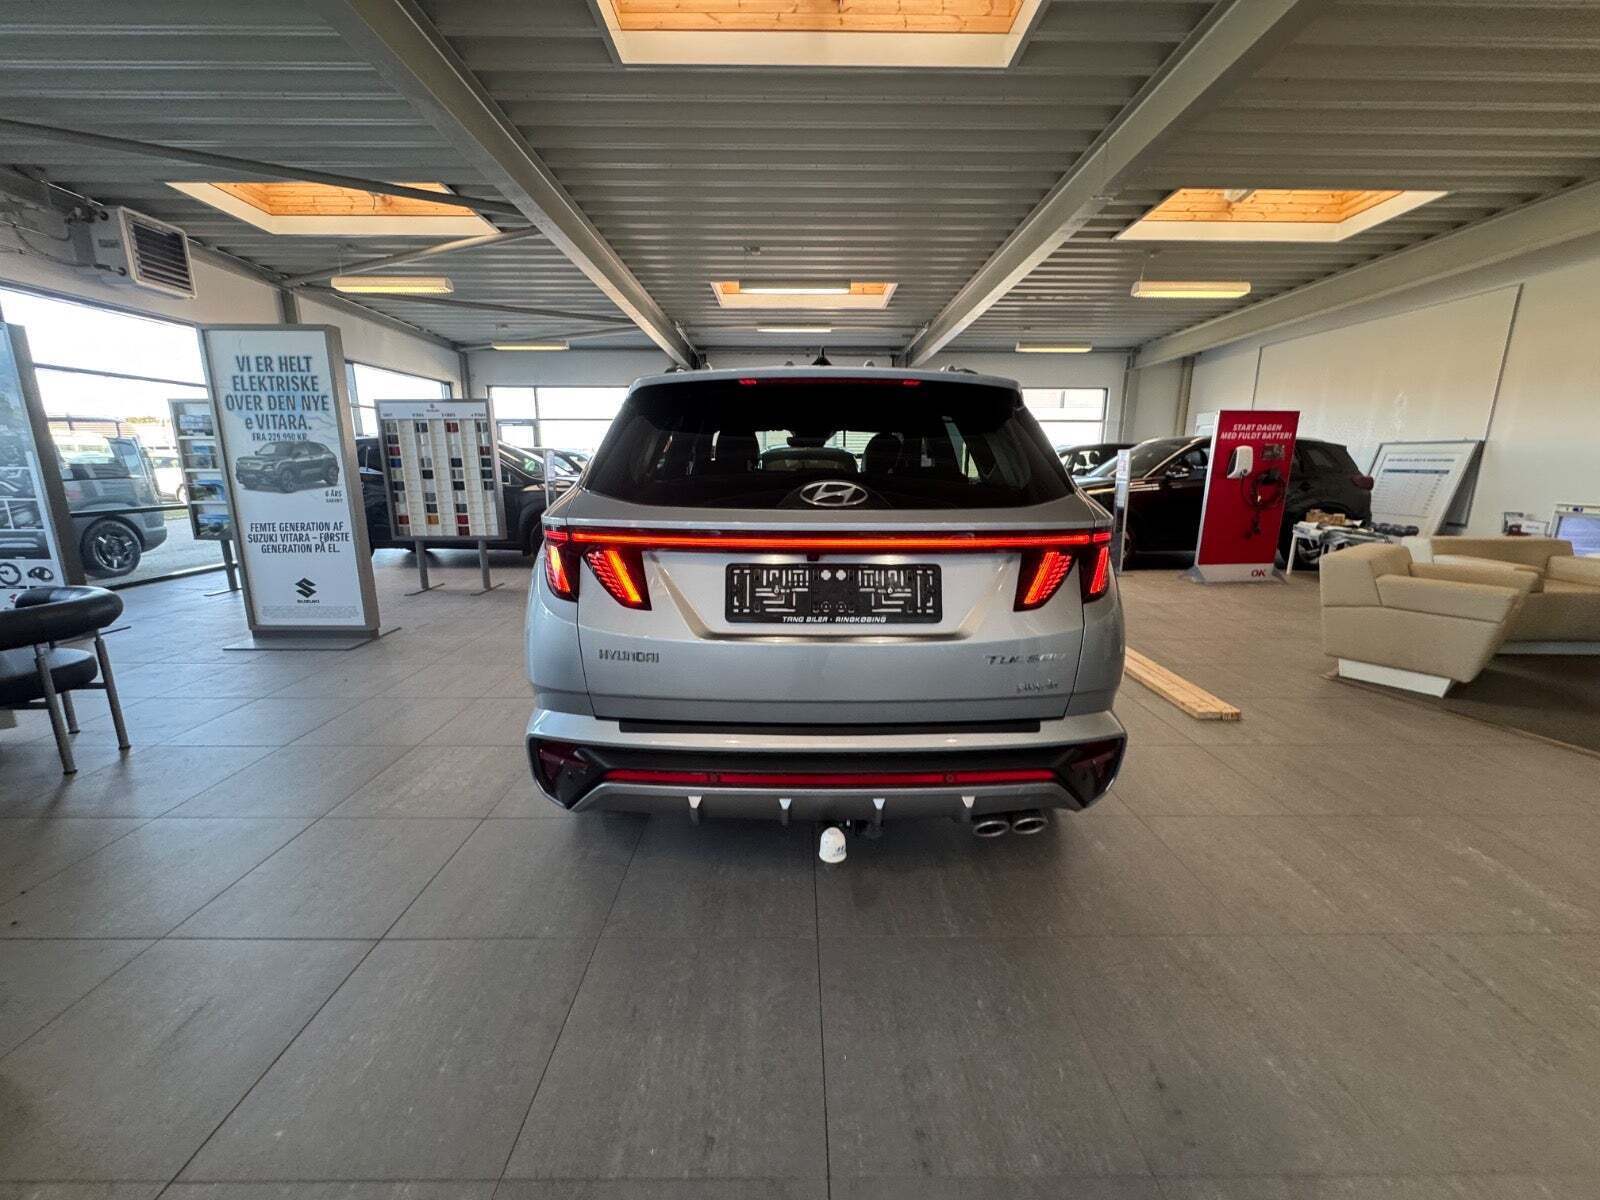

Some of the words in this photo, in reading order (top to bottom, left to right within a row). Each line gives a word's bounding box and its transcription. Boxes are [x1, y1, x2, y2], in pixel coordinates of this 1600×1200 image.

[235, 355, 251, 373] VI
[255, 355, 274, 373] ER
[278, 355, 313, 373] HELT
[232, 375, 319, 392] ELEKTRISKE
[225, 394, 263, 411] OVER
[267, 394, 296, 411] DEN
[301, 394, 330, 411] NYE
[245, 416, 254, 430] e
[255, 414, 312, 430] VITARA.
[1233, 423, 1256, 431] START
[1256, 423, 1283, 431] DAGEN
[1220, 432, 1237, 440] MED
[1237, 432, 1261, 440] FULDT
[250, 522, 277, 532] FEMTE
[279, 522, 331, 532] GENERATION
[333, 521, 344, 532] AF
[247, 533, 278, 543] SUZUKI
[280, 533, 310, 543] VITARA
[319, 532, 350, 543] FØRSTE
[261, 543, 313, 554] GENERATION
[315, 542, 326, 553] PÅ
[328, 543, 341, 553] EL.
[835, 615, 887, 623] RINGKØBING
[599, 649, 660, 663] HYUNDAI
